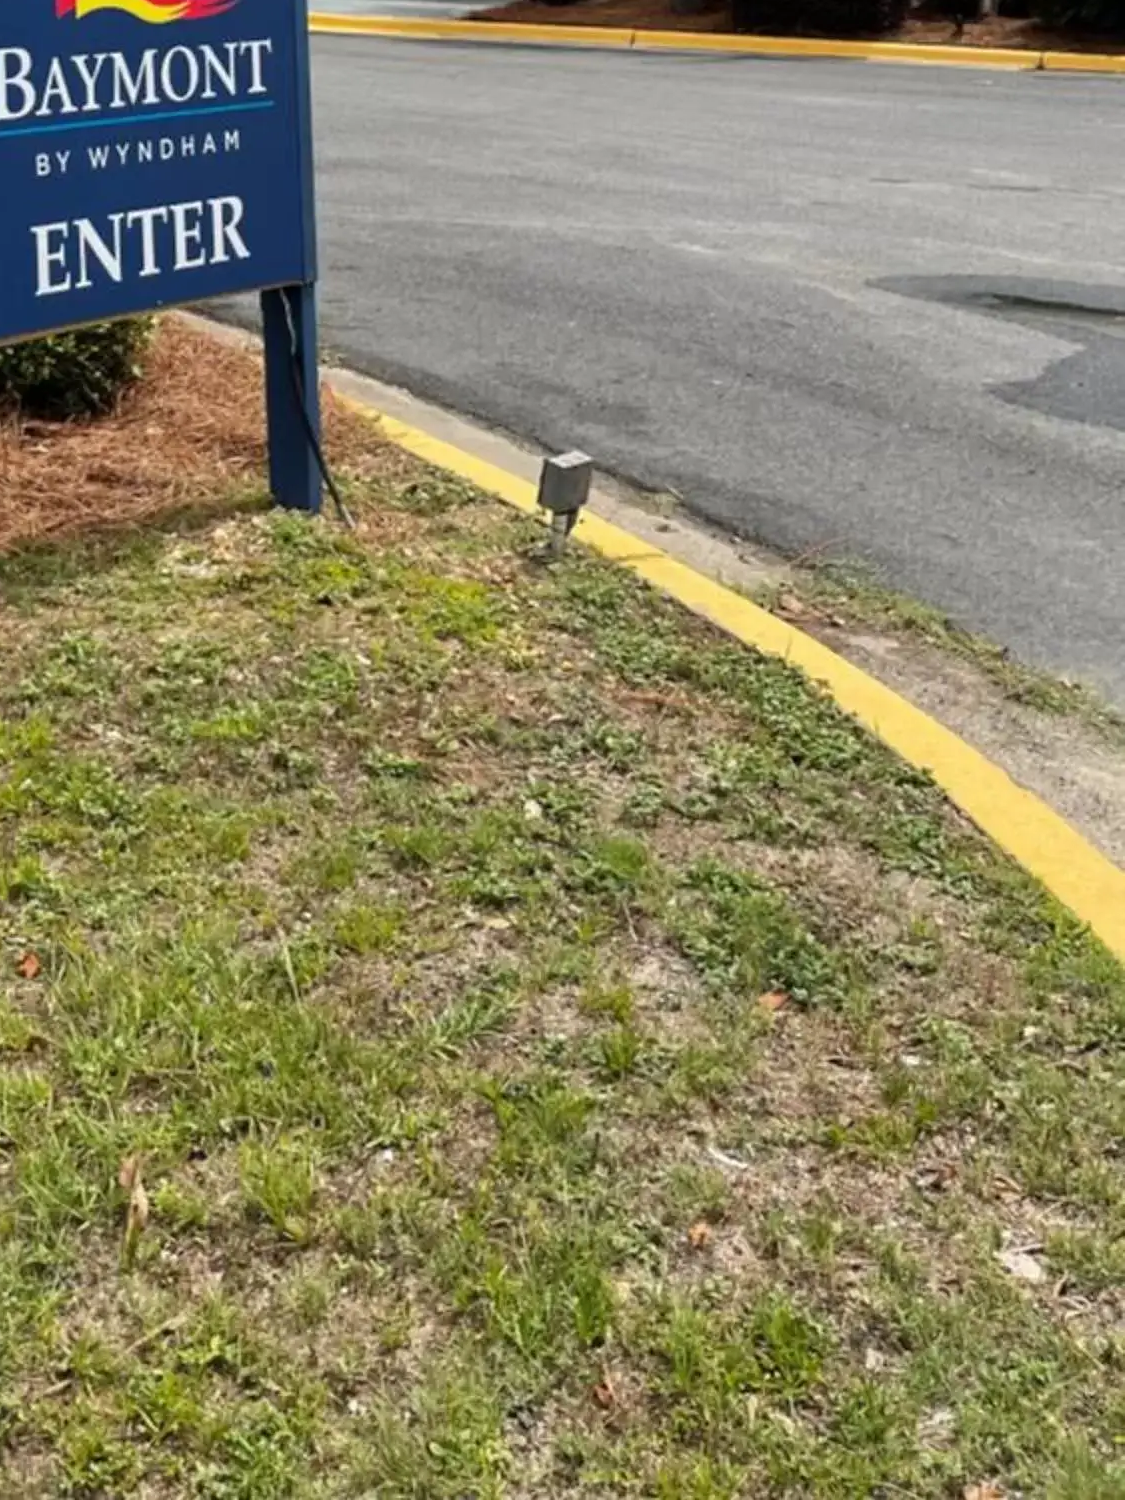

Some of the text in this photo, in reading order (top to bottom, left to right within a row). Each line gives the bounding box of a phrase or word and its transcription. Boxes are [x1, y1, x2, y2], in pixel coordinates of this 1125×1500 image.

[35, 129, 241, 176] BY WYNDHAM
[30, 195, 251, 297] ENTER
